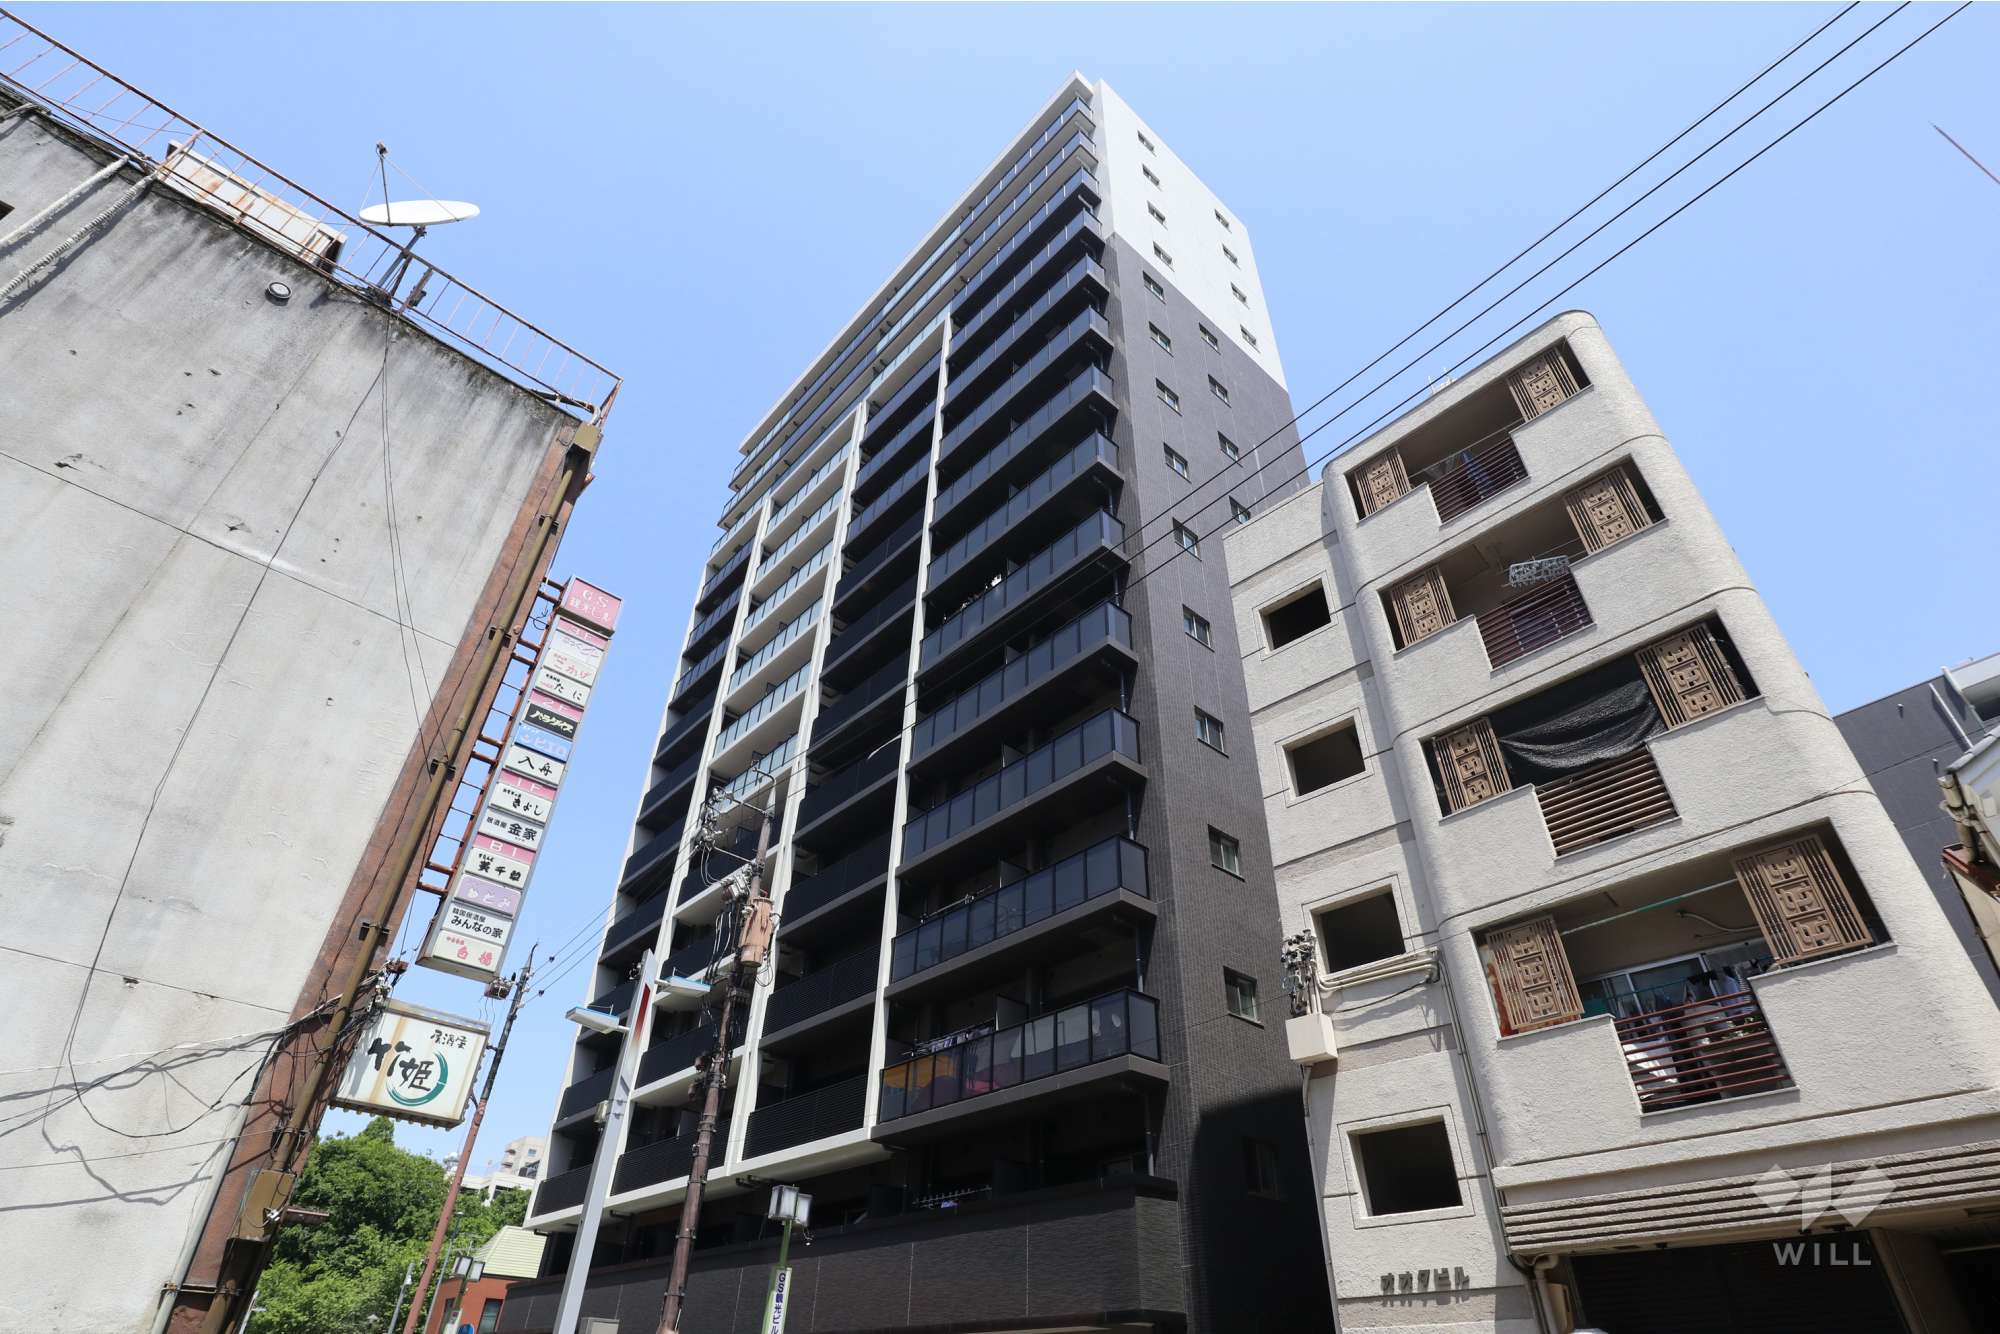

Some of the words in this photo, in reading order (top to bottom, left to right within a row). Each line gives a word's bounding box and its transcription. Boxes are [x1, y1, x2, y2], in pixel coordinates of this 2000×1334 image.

[508, 823, 538, 842] 金家
[451, 915, 503, 939] みんなの家
[367, 1037, 434, 1092] 竹姫
